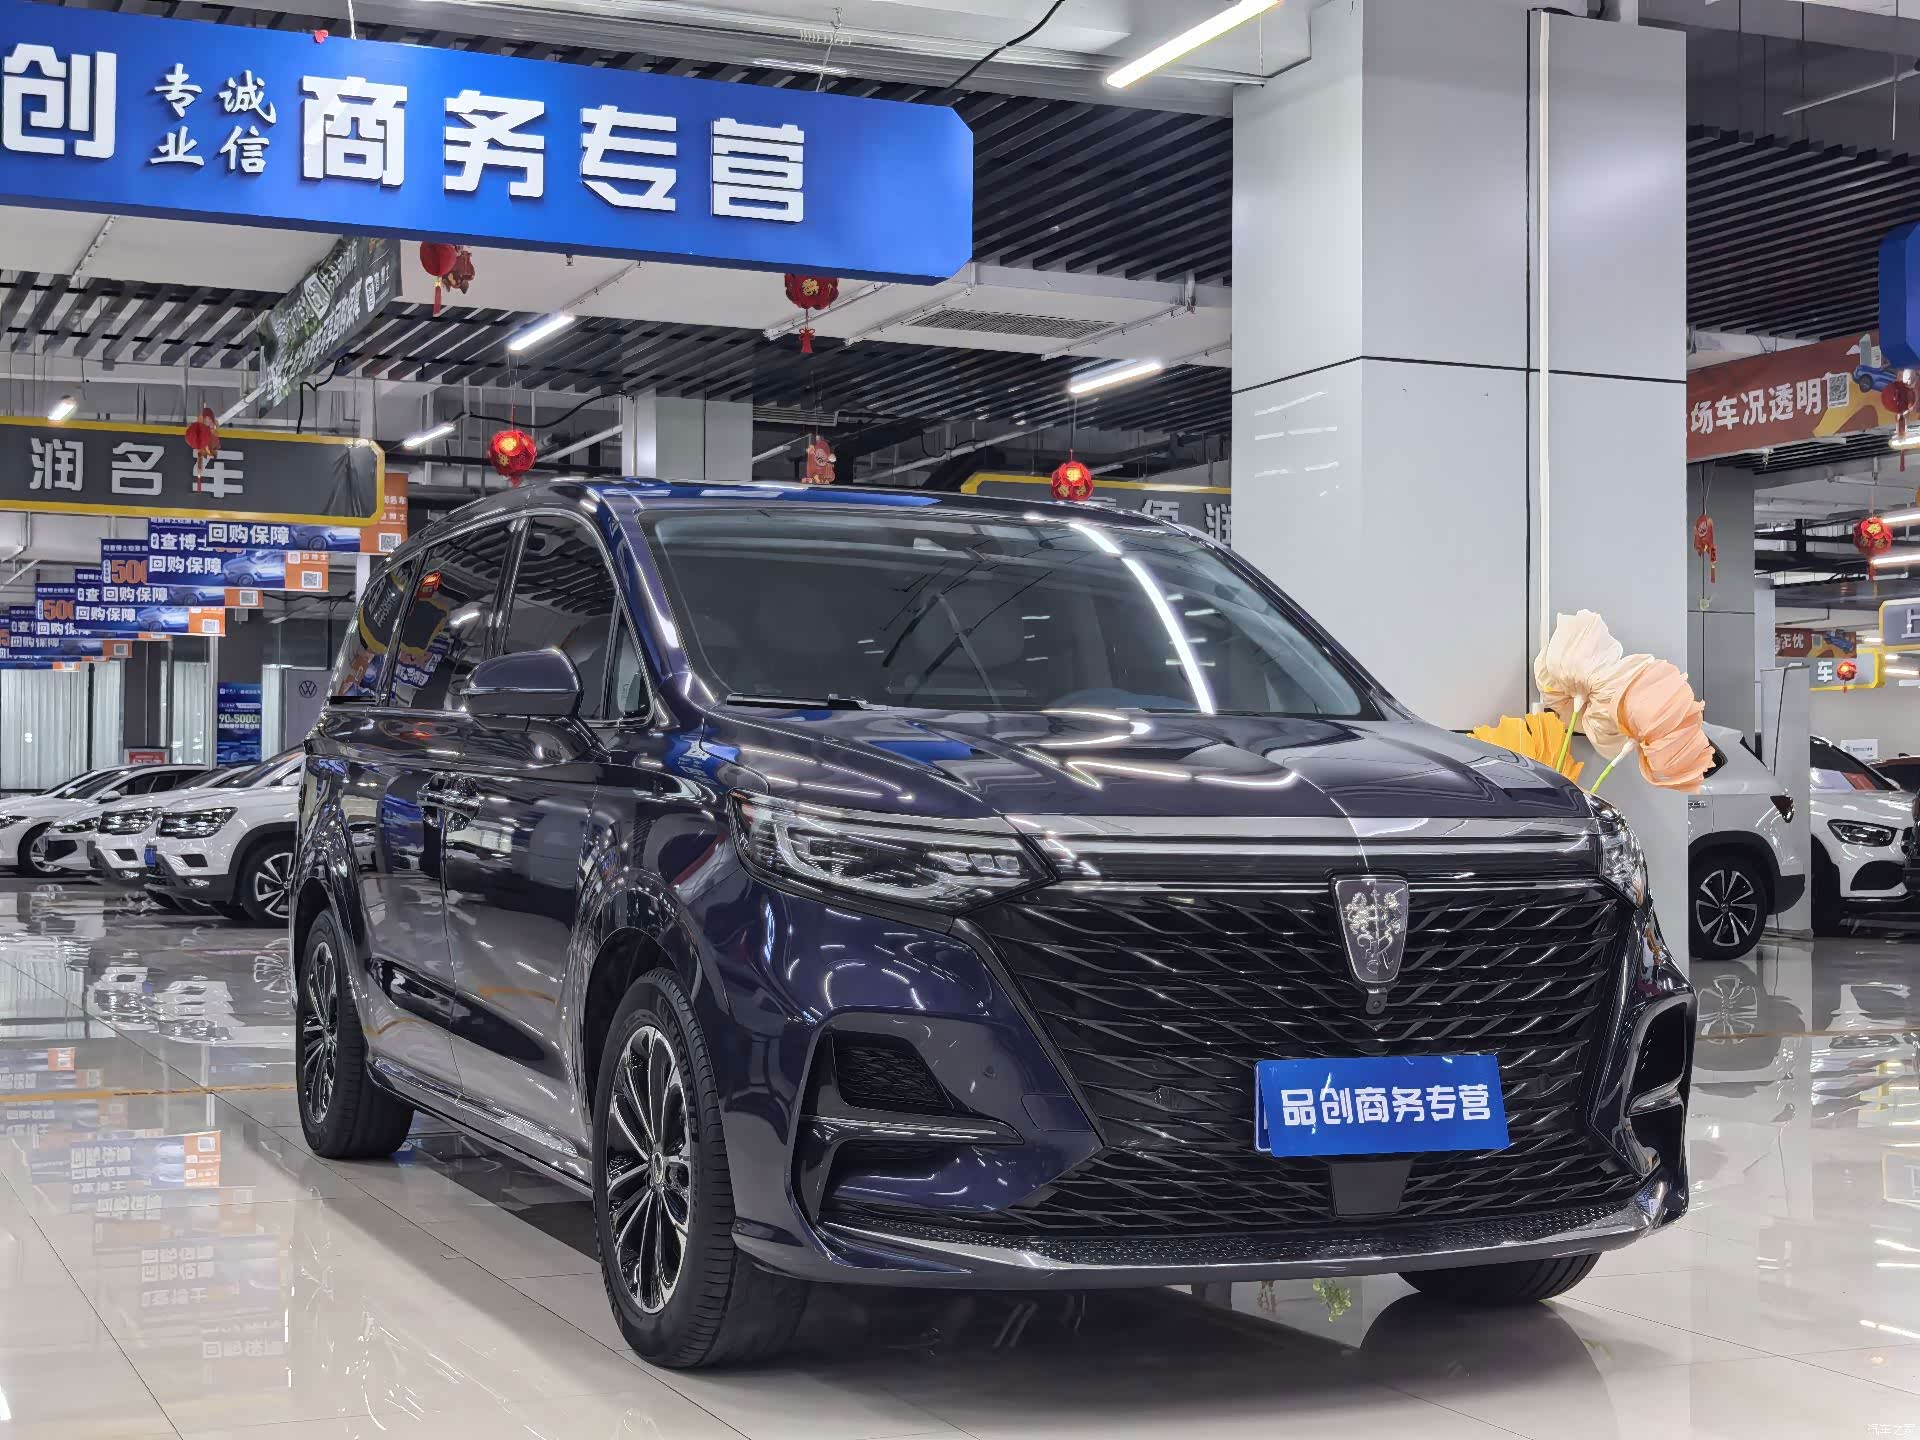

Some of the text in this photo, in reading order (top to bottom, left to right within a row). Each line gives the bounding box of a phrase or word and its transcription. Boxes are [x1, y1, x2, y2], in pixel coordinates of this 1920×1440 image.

[3, 42, 806, 223] 创 商务专营
[1690, 377, 1822, 434] 场车况透明
[29, 437, 244, 498] 润名车
[208, 523, 290, 545] 回购保障
[149, 555, 222, 576] 回购保障
[103, 586, 168, 603] 回购保障
[75, 605, 136, 622] 回购保障
[1280, 1083, 1491, 1127] 品创商务专营
